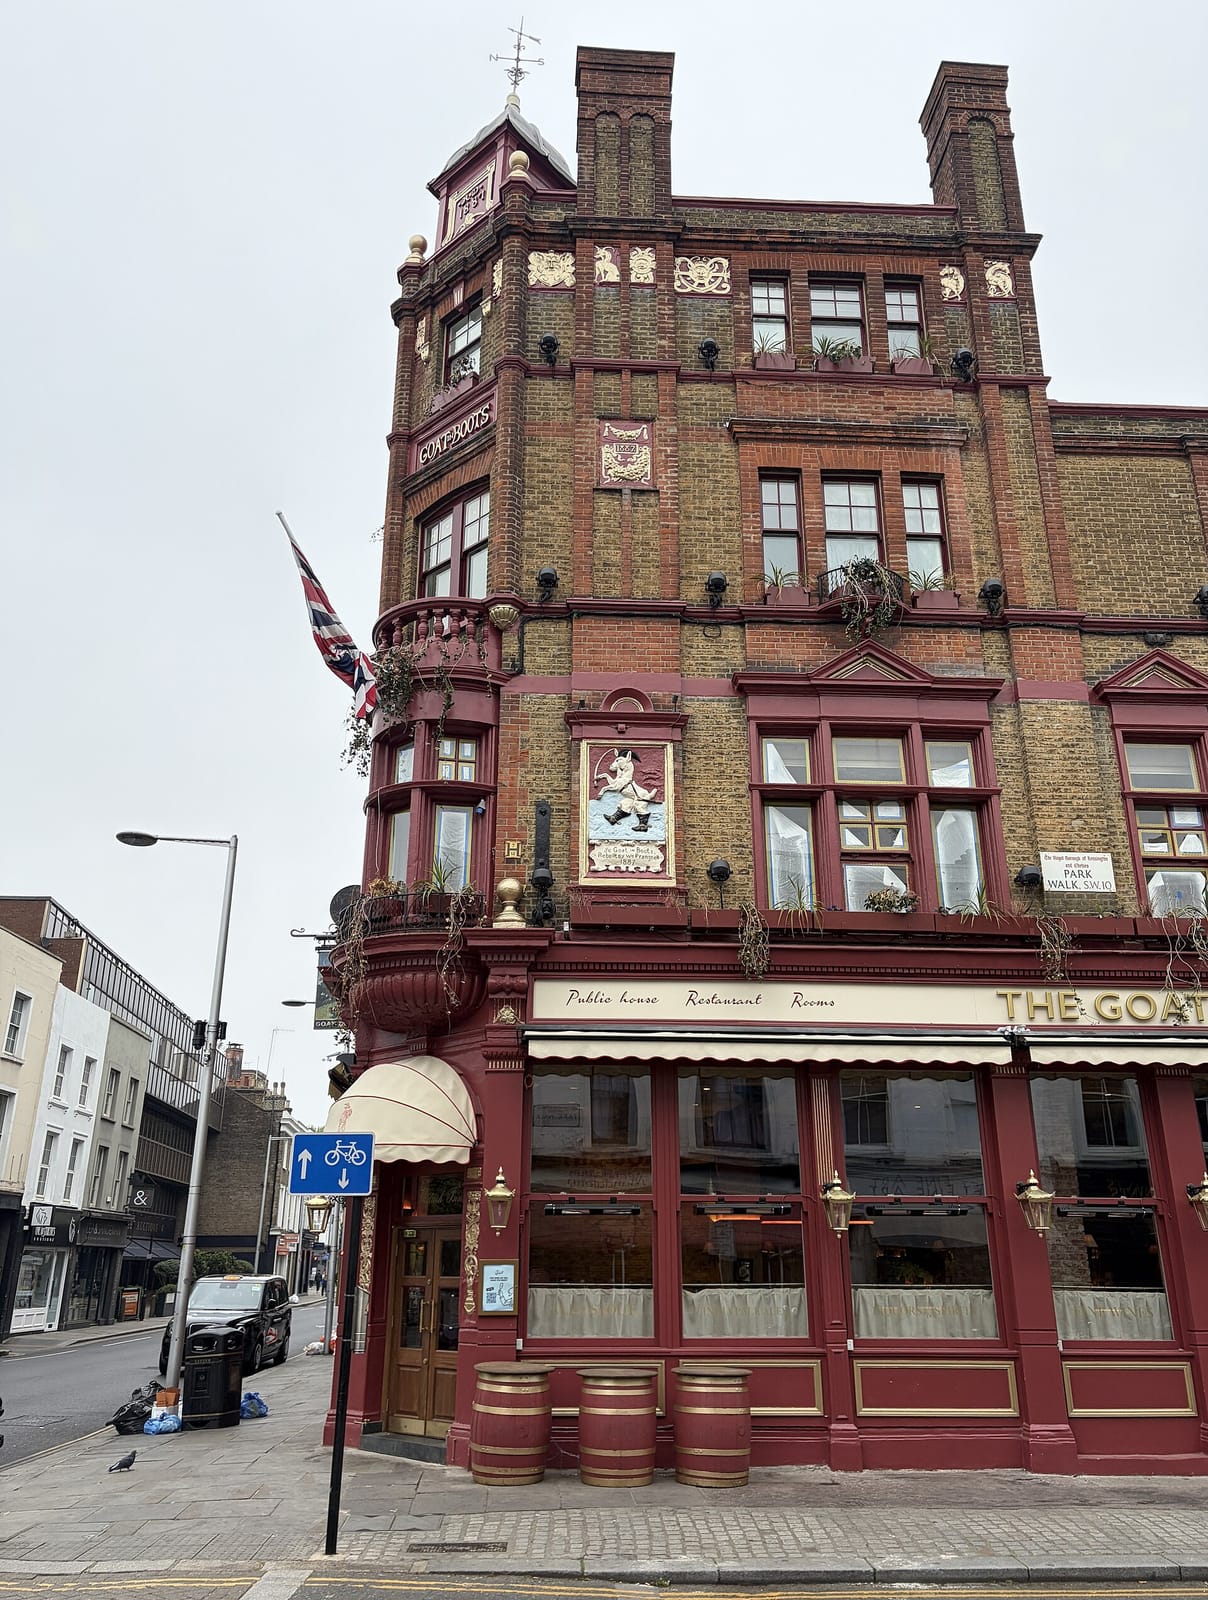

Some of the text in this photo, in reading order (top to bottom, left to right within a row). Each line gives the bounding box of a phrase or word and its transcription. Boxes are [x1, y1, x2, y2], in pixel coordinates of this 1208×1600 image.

[420, 431, 451, 464] GOAT
[452, 402, 490, 444] BOOTS
[1064, 869, 1093, 879] PARK
[1083, 880, 1112, 890] S.W.10
[565, 989, 836, 1009] Public house Restaurant Rooms
[996, 991, 1208, 1022] THE GOAT
[133, 1190, 148, 1206] &
